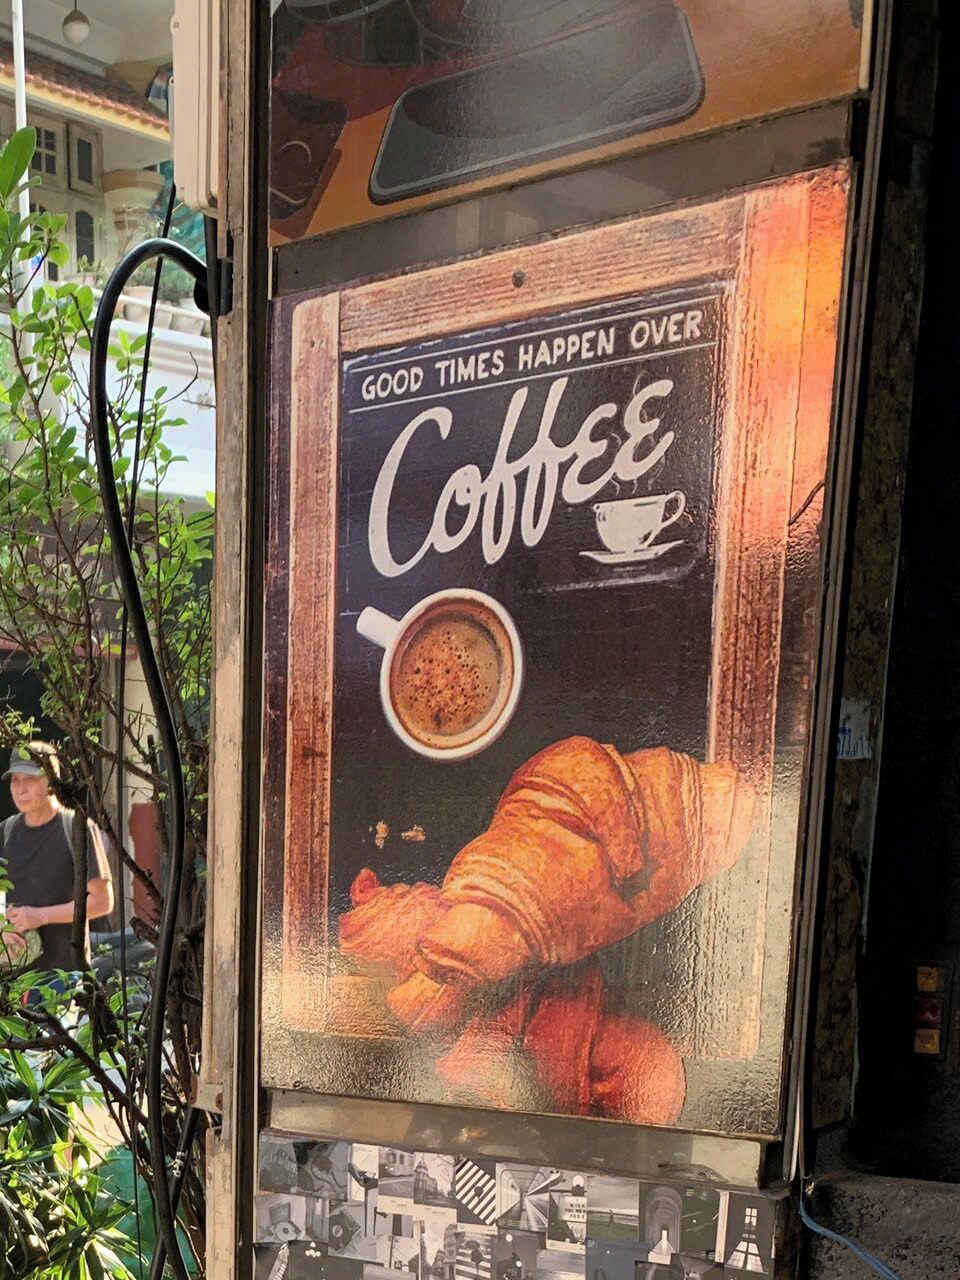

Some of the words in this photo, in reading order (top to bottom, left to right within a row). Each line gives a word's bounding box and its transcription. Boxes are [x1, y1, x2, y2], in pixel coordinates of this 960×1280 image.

[362, 369, 424, 401] GOOD
[435, 349, 505, 387] TIMES
[518, 327, 615, 372] HAPPEN
[630, 309, 704, 348] OVER
